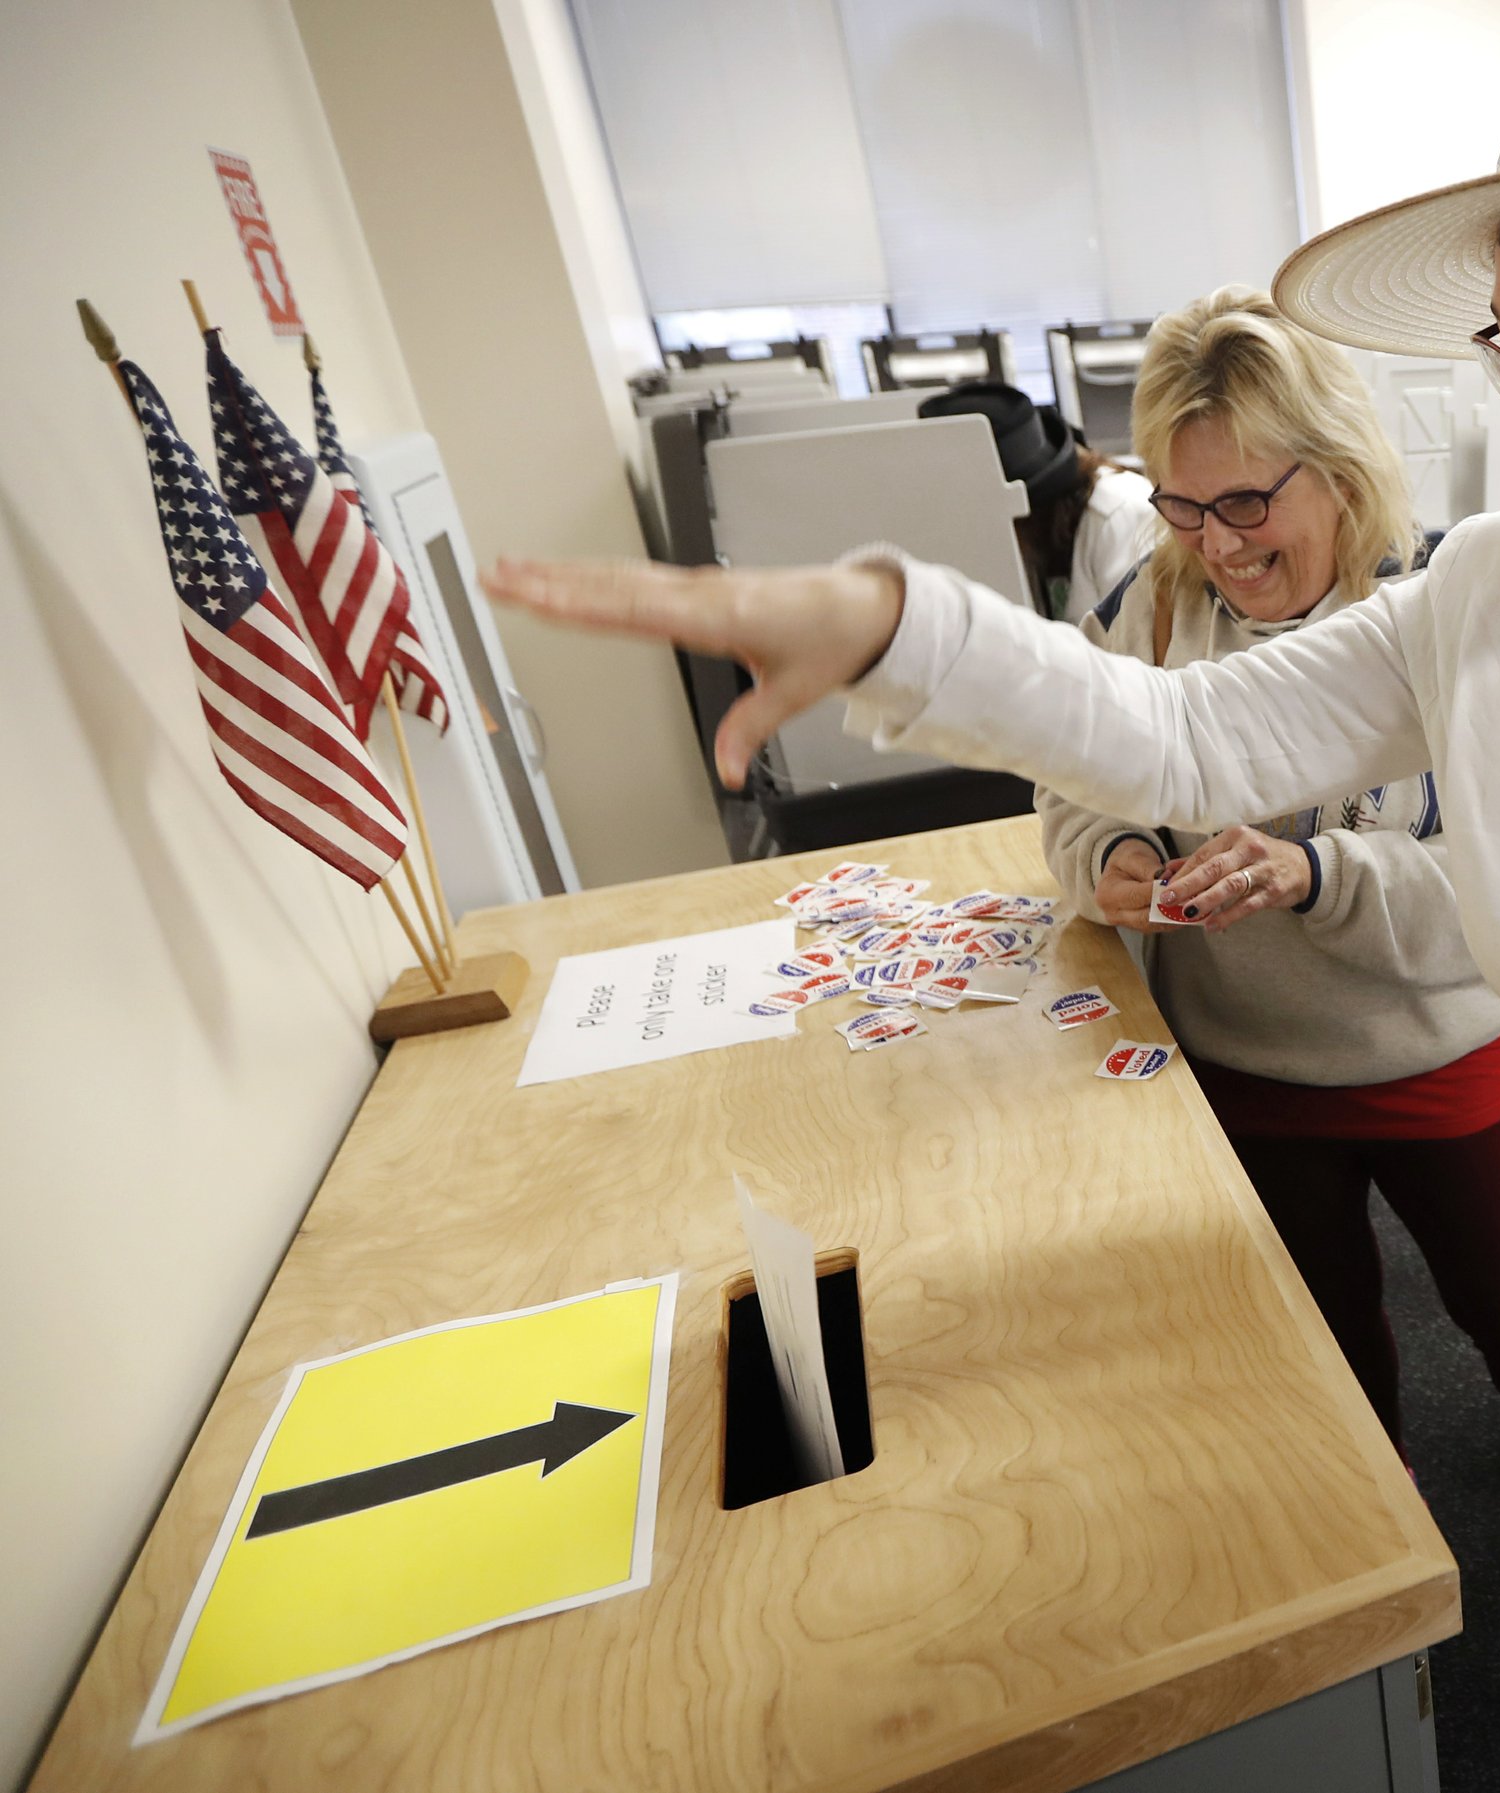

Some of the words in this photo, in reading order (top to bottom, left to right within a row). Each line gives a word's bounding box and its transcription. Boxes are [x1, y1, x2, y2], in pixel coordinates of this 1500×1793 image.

[654, 952, 678, 978] one
[642, 977, 674, 1007] take
[697, 964, 728, 1007] sticker
[576, 983, 616, 1029] Please
[1058, 1001, 1102, 1018] Voted
[635, 1009, 675, 1041] only
[1126, 1049, 1152, 1074] Voted
